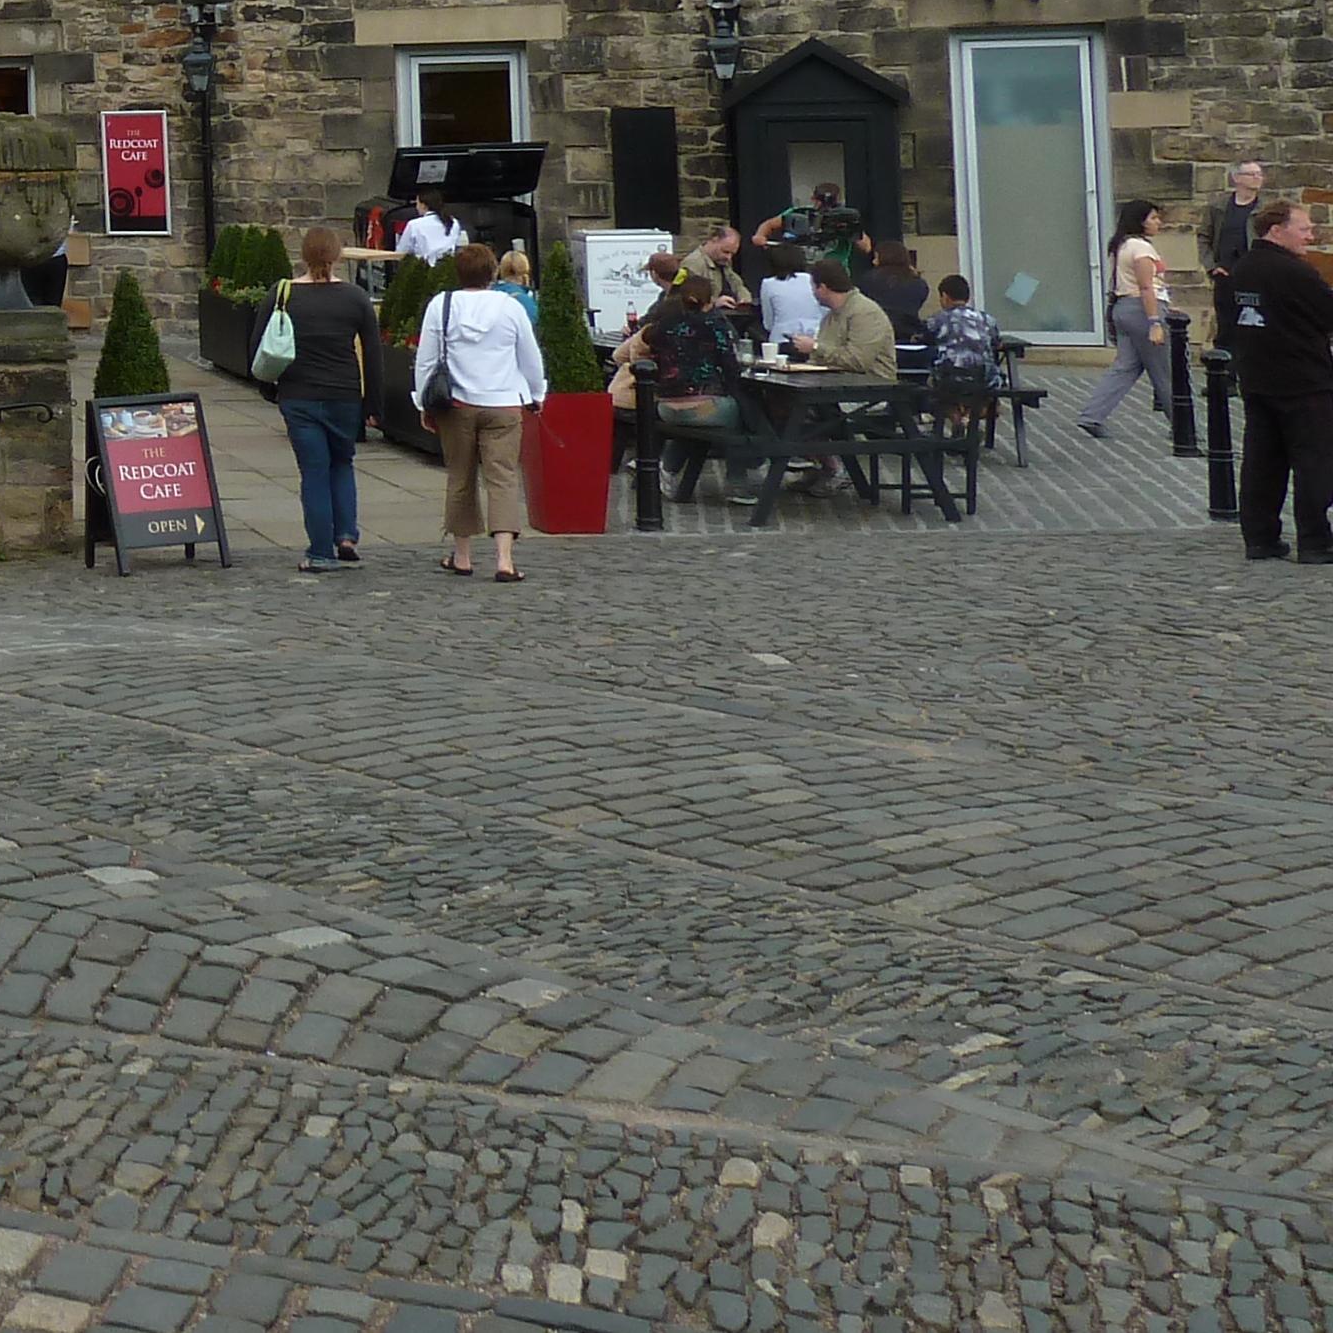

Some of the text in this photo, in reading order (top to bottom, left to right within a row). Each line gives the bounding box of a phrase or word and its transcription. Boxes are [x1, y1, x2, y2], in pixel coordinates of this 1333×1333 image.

[109, 138, 159, 149] REDCOAT
[121, 150, 148, 162] CAFE
[141, 447, 167, 459] THE
[118, 461, 196, 481] REDCOAT
[140, 483, 182, 499] CAFE
[148, 519, 188, 534] OPEN
